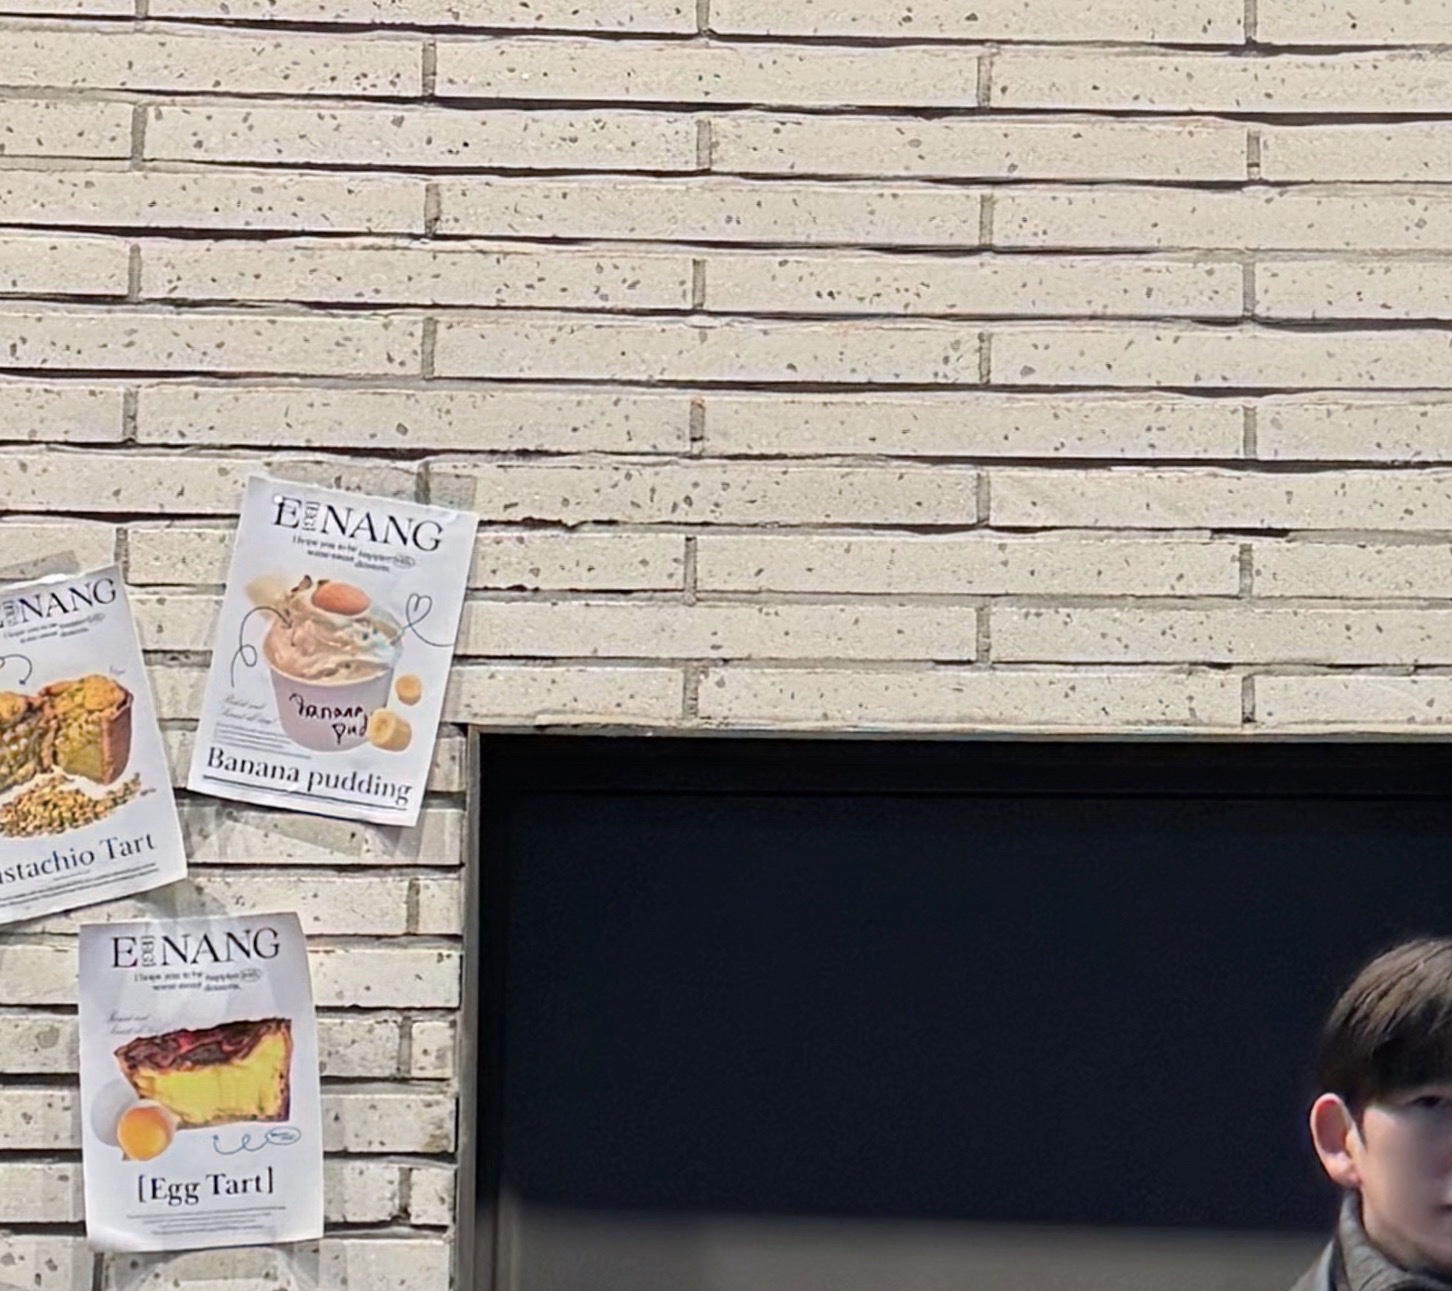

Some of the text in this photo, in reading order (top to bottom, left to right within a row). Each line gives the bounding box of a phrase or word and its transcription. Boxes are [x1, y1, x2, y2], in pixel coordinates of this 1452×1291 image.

[207, 746, 413, 806] Banana pudding
[99, 833, 156, 861] Tart
